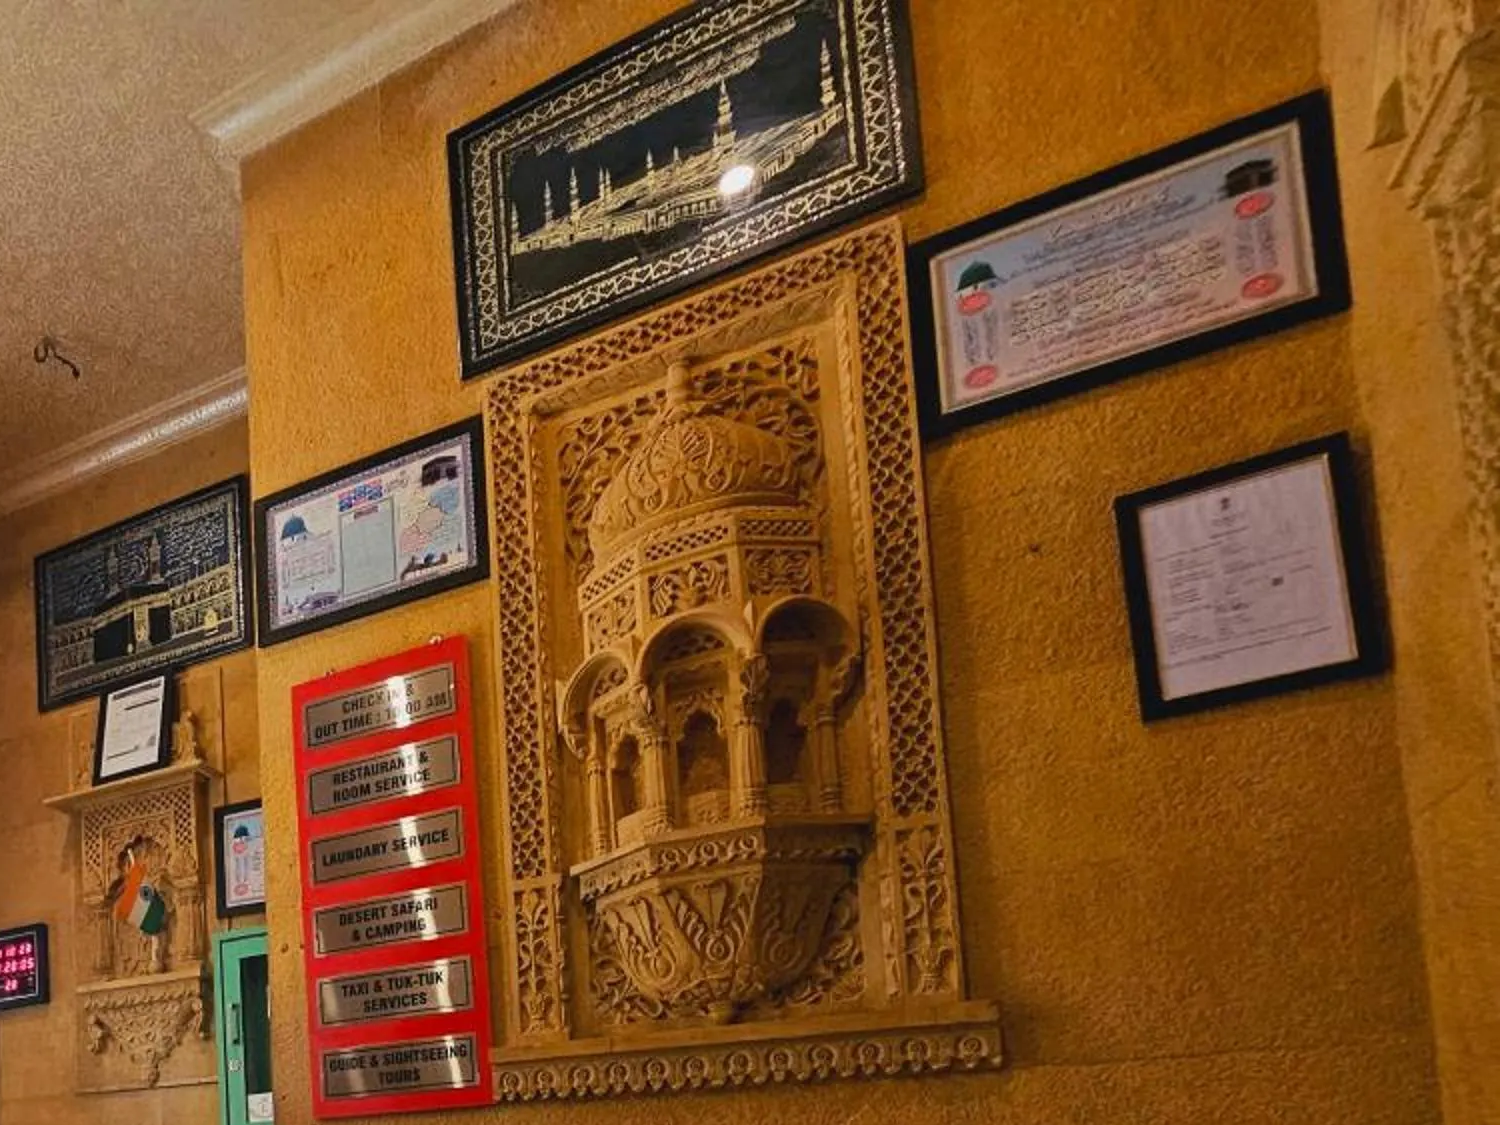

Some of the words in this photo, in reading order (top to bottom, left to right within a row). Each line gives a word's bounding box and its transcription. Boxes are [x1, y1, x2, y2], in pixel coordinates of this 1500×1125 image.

[342, 691, 385, 713] CHECK
[405, 683, 414, 696] &
[315, 722, 338, 739] OUT
[342, 715, 373, 734] TIME
[426, 691, 448, 708] AM
[333, 755, 415, 784] RESTAURANT
[419, 751, 430, 764] &
[333, 784, 371, 804] ROOM
[375, 768, 431, 793] SERVICE
[322, 841, 388, 866] LAUNDARY
[392, 828, 450, 852] SERVICE
[338, 904, 388, 927] DESERT
[391, 897, 439, 917] SAFARI
[352, 929, 361, 942] &
[365, 917, 427, 941] CAMPING
[341, 982, 370, 998] TAXI
[373, 980, 383, 993] &
[387, 970, 444, 991] TUK-TUK
[363, 992, 428, 1014] SERVICES
[329, 1055, 368, 1072] GUIDE
[370, 1055, 379, 1068] &
[382, 1044, 468, 1067] SIGHTSEEING
[378, 1067, 421, 1086] TOURS
